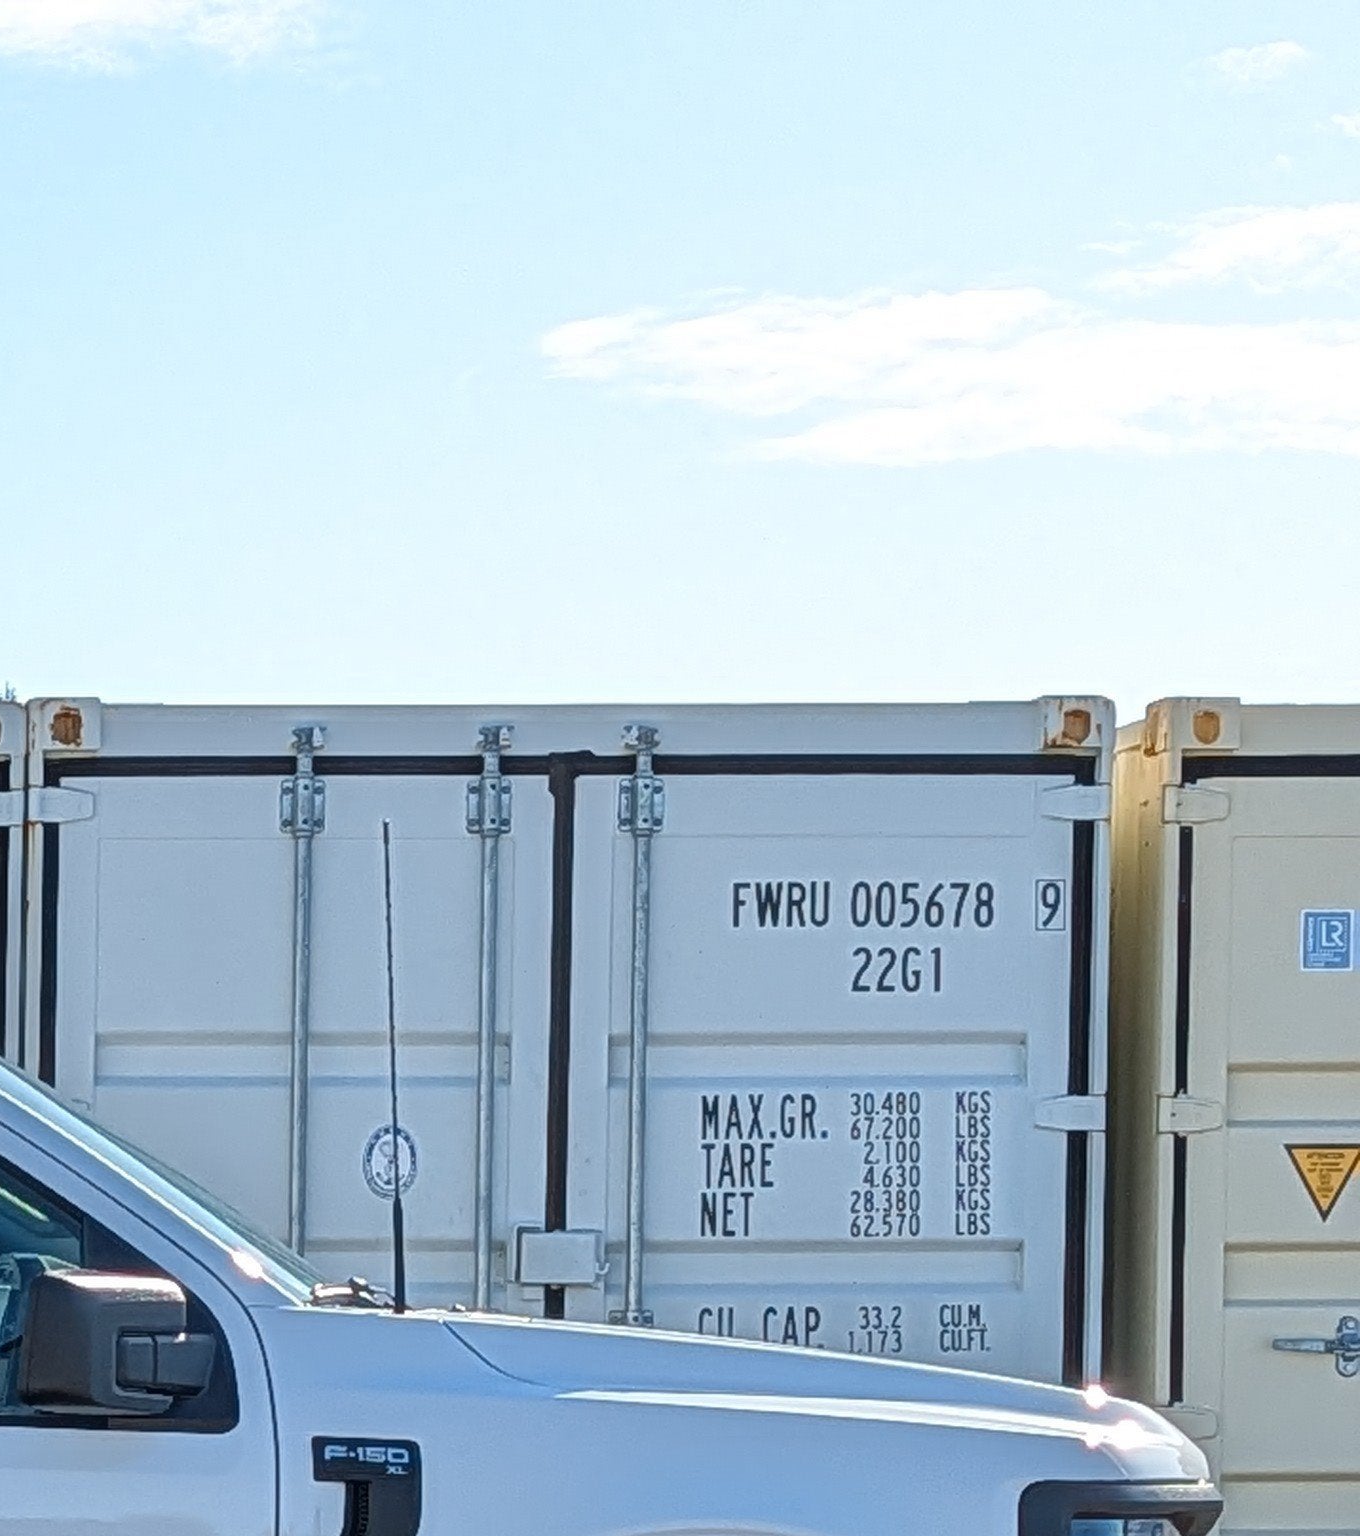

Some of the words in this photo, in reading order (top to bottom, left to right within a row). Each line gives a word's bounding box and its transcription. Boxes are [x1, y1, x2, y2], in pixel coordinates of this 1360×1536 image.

[732, 880, 831, 928] FWRU
[850, 881, 994, 928] 005678
[1041, 882, 1061, 928] 9
[851, 946, 941, 993] 22G1
[850, 1092, 921, 1116] 30.480
[954, 1092, 992, 1116] KGS
[850, 1116, 921, 1140] 67.200
[954, 1116, 992, 1140] LBS
[863, 1141, 921, 1165] 2.100
[954, 1141, 992, 1165] KGS
[700, 1142, 775, 1189] TARE
[862, 1165, 921, 1189] 4.630
[954, 1165, 992, 1189] LBS
[850, 1190, 921, 1213] 28.380
[954, 1190, 992, 1213] KGS
[700, 1191, 755, 1237] NET
[850, 1213, 921, 1237] 62.570
[954, 1213, 992, 1237] LBS
[858, 1306, 902, 1330] 33.2
[847, 1330, 903, 1354] 1.173
[324, 1445, 410, 1464] F-150
